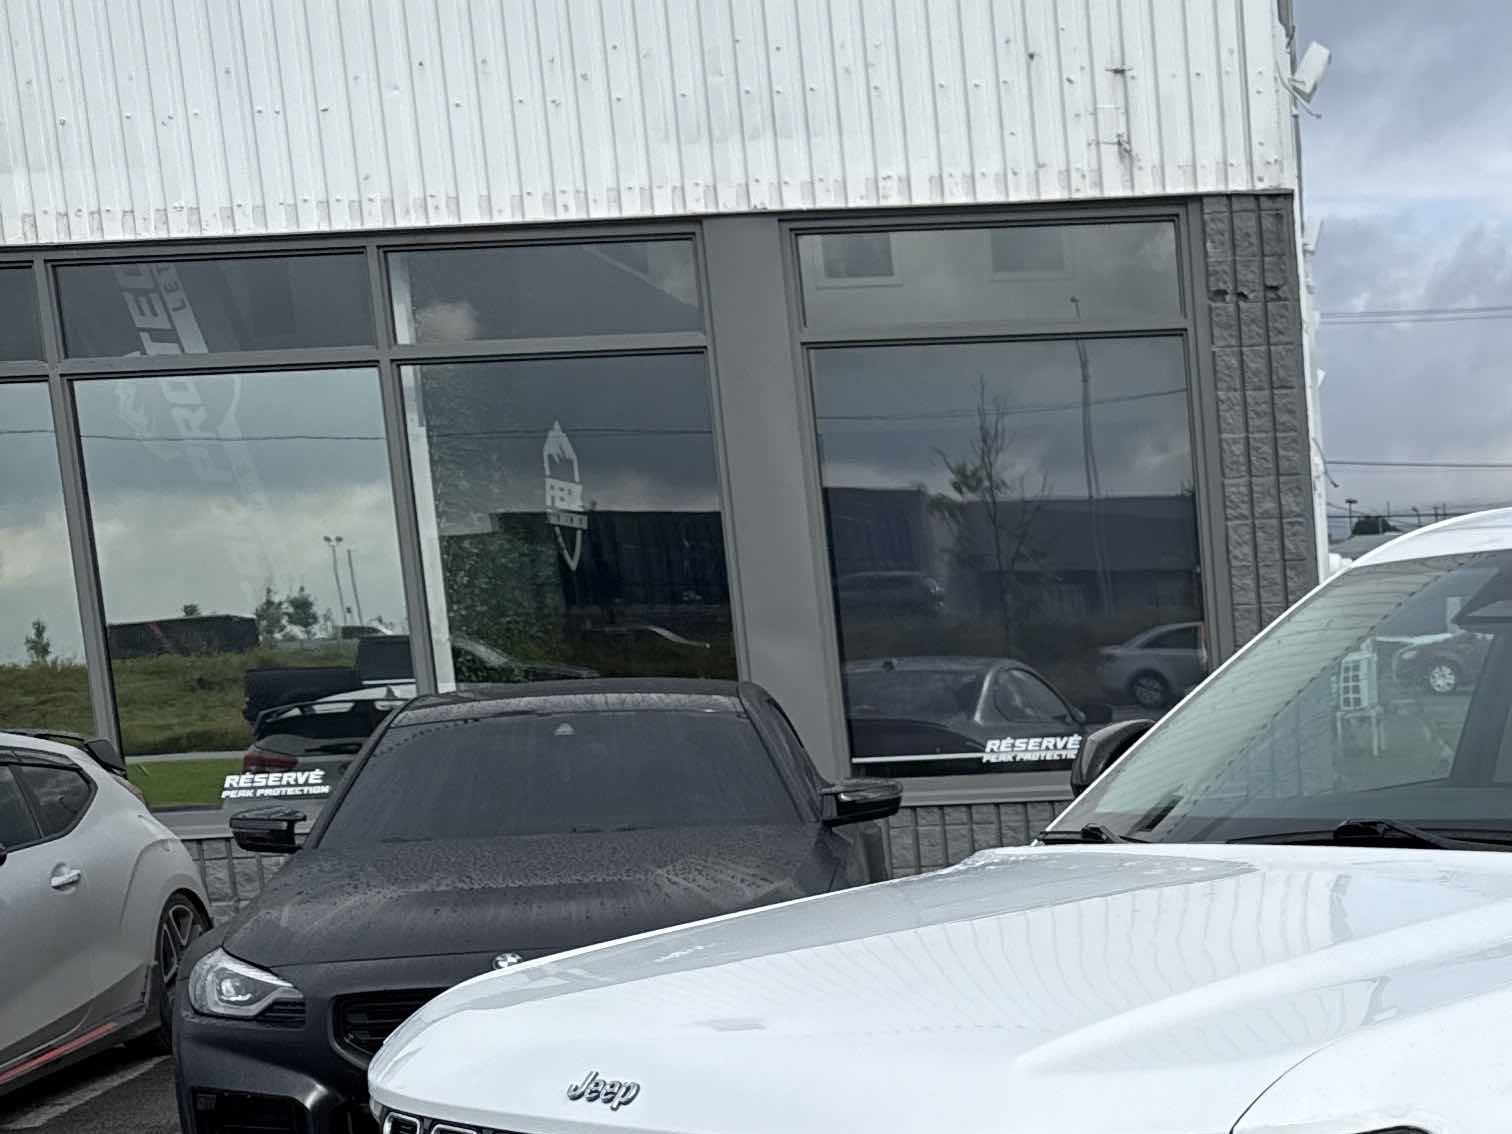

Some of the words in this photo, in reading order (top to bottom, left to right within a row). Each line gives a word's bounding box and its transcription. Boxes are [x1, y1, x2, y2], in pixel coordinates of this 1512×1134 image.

[985, 734, 1082, 752] RÉSERVÉ
[224, 769, 325, 788] RÉSERVÉ
[221, 789, 254, 798] PEAK
[256, 785, 330, 797] PROTECTION
[567, 1070, 640, 1111] Jeep
